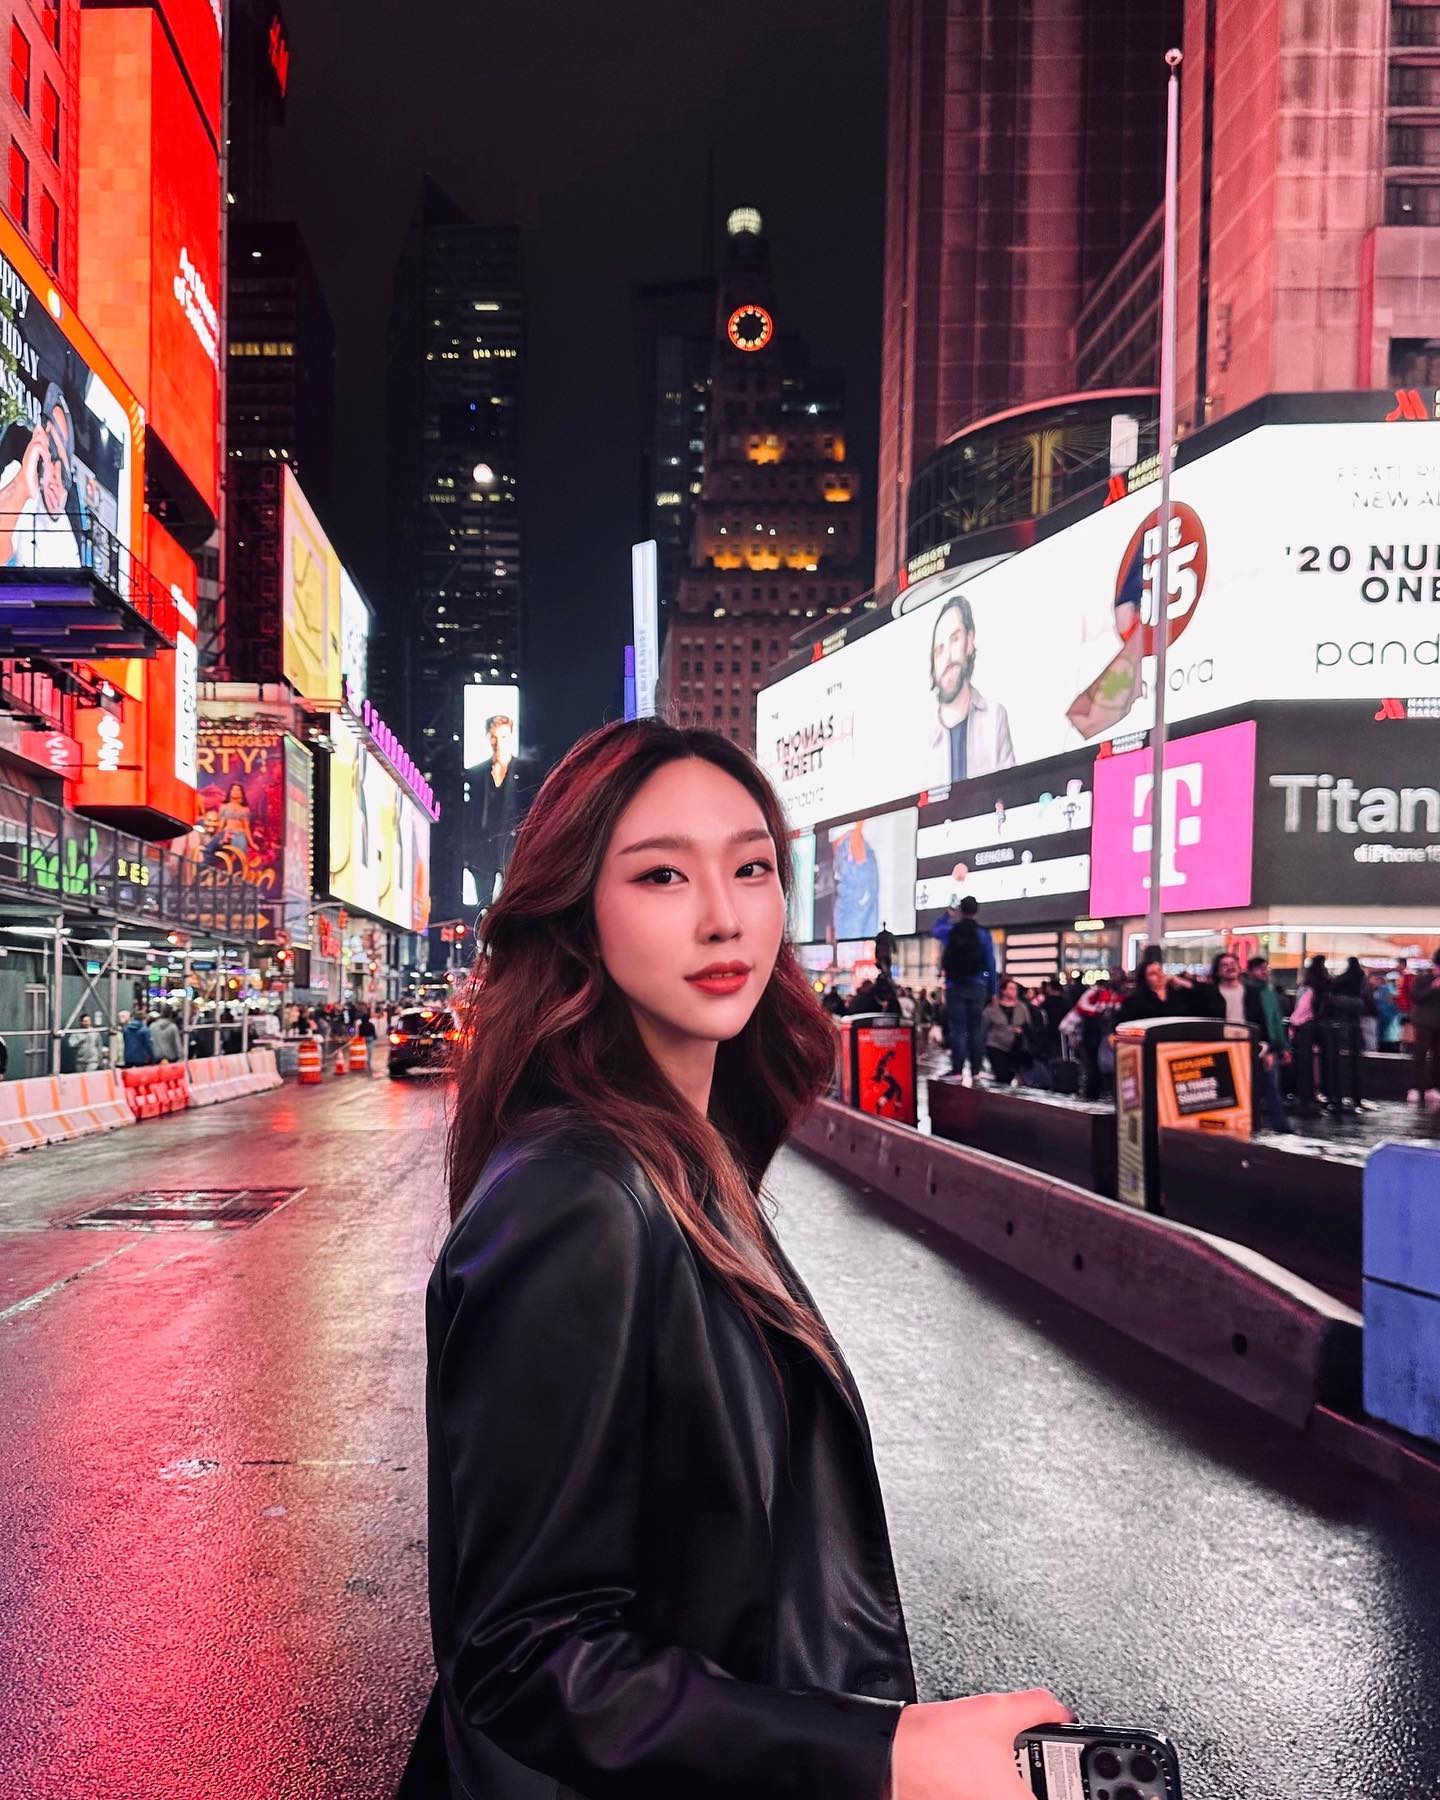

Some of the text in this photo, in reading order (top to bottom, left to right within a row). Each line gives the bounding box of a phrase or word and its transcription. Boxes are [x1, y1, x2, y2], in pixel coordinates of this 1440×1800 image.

[1353, 490, 1409, 508] NEW
[1284, 545, 1440, 572] '20 NU
[1314, 633, 1440, 673] pand
[222, 735, 279, 748] BIGGEST
[776, 713, 834, 762] THOMAS
[196, 747, 268, 774] RTY!
[782, 746, 824, 781] RHETT
[1269, 773, 1440, 834] Titan
[975, 848, 1015, 866] SEPHORA
